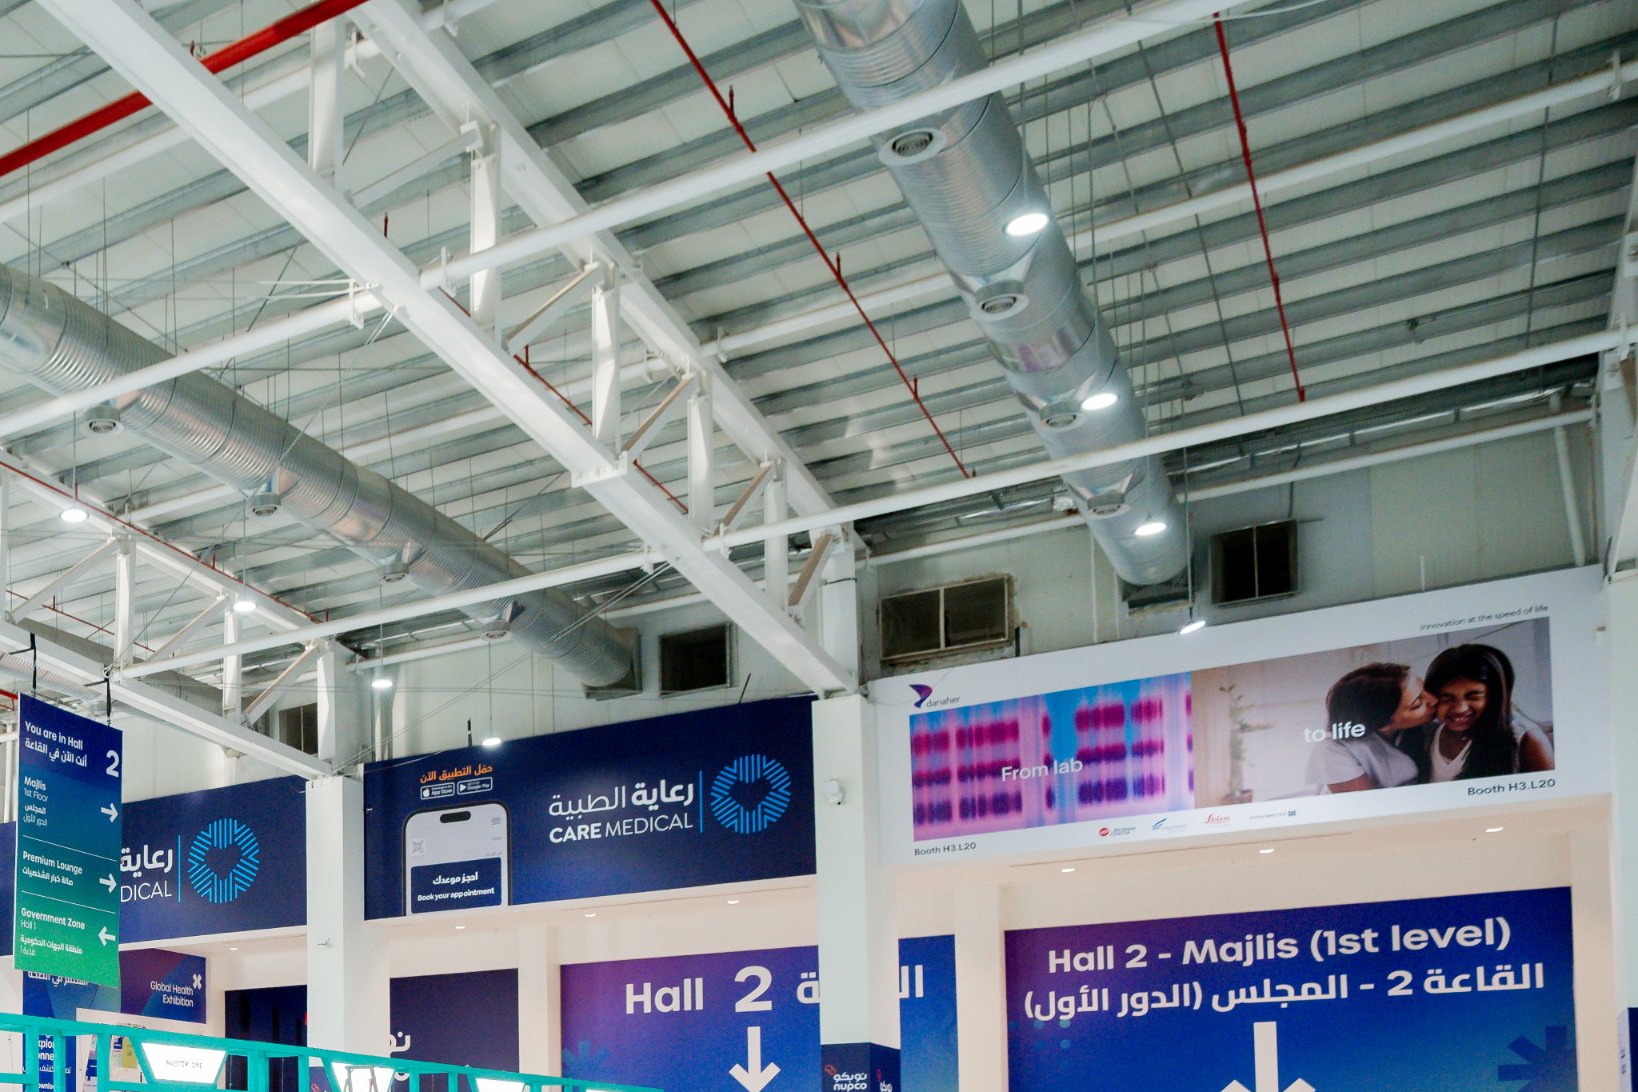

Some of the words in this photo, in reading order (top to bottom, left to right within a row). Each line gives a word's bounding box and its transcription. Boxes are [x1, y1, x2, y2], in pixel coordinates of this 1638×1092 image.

[1468, 616, 1476, 624] at
[1478, 612, 1493, 622] the
[1494, 608, 1522, 620] speed
[1524, 606, 1533, 615] of
[1533, 603, 1549, 613] life
[926, 696, 961, 708] danaher
[25, 721, 41, 736] You
[43, 729, 57, 741] are
[59, 732, 66, 743] in
[67, 738, 83, 750] Hall
[1303, 726, 1326, 743] to
[1331, 721, 1366, 741] life
[24, 737, 47, 754] القاعة
[49, 748, 60, 762] في
[60, 750, 74, 763] الآن
[75, 754, 87, 767] أنت
[106, 749, 119, 778] 2
[420, 771, 437, 784] الآن
[438, 766, 472, 781] التطبيق
[1002, 765, 1049, 782] From
[1053, 757, 1083, 774] lab
[24, 776, 47, 791] Majlis
[1467, 784, 1505, 796] Booth
[1508, 778, 1556, 791] H3.L20
[548, 785, 626, 821] الطبية
[631, 778, 694, 811] رعاية
[24, 803, 47, 815] المجلس
[549, 822, 602, 844] CARE
[605, 812, 693, 837] MEDICAL
[914, 845, 941, 856] Booth
[943, 842, 976, 853] H3.L20
[22, 850, 55, 868] Premium
[56, 862, 83, 875] Lounge
[61, 876, 74, 886] صالة
[432, 875, 461, 886] موعدك
[462, 871, 478, 883] احجز
[120, 880, 172, 903] DICAL
[417, 893, 434, 902] Book
[434, 892, 450, 901] your
[450, 886, 495, 899] appointment
[21, 907, 66, 926] Government
[67, 917, 85, 930] Zone
[21, 920, 33, 930] Hall
[20, 934, 46, 948] الحكومية
[65, 944, 83, 955] منطقة
[1048, 945, 1114, 973] Hall
[1125, 944, 1148, 969] 2
[1182, 932, 1299, 967] Majlis
[1310, 928, 1379, 962] (1st
[1391, 916, 1511, 951] level)
[1387, 970, 1413, 997] 2
[1423, 962, 1544, 995] القاعة
[150, 980, 172, 992] Global
[173, 984, 193, 996] Health
[626, 977, 704, 1014] Hall
[734, 965, 773, 1013] 2
[1211, 974, 1348, 1013] المجلس
[162, 994, 194, 1008] Exhibition
[1024, 985, 1109, 1022] الأول)
[1117, 981, 1203, 1018] (الدور
[833, 1082, 867, 1092] nupco
